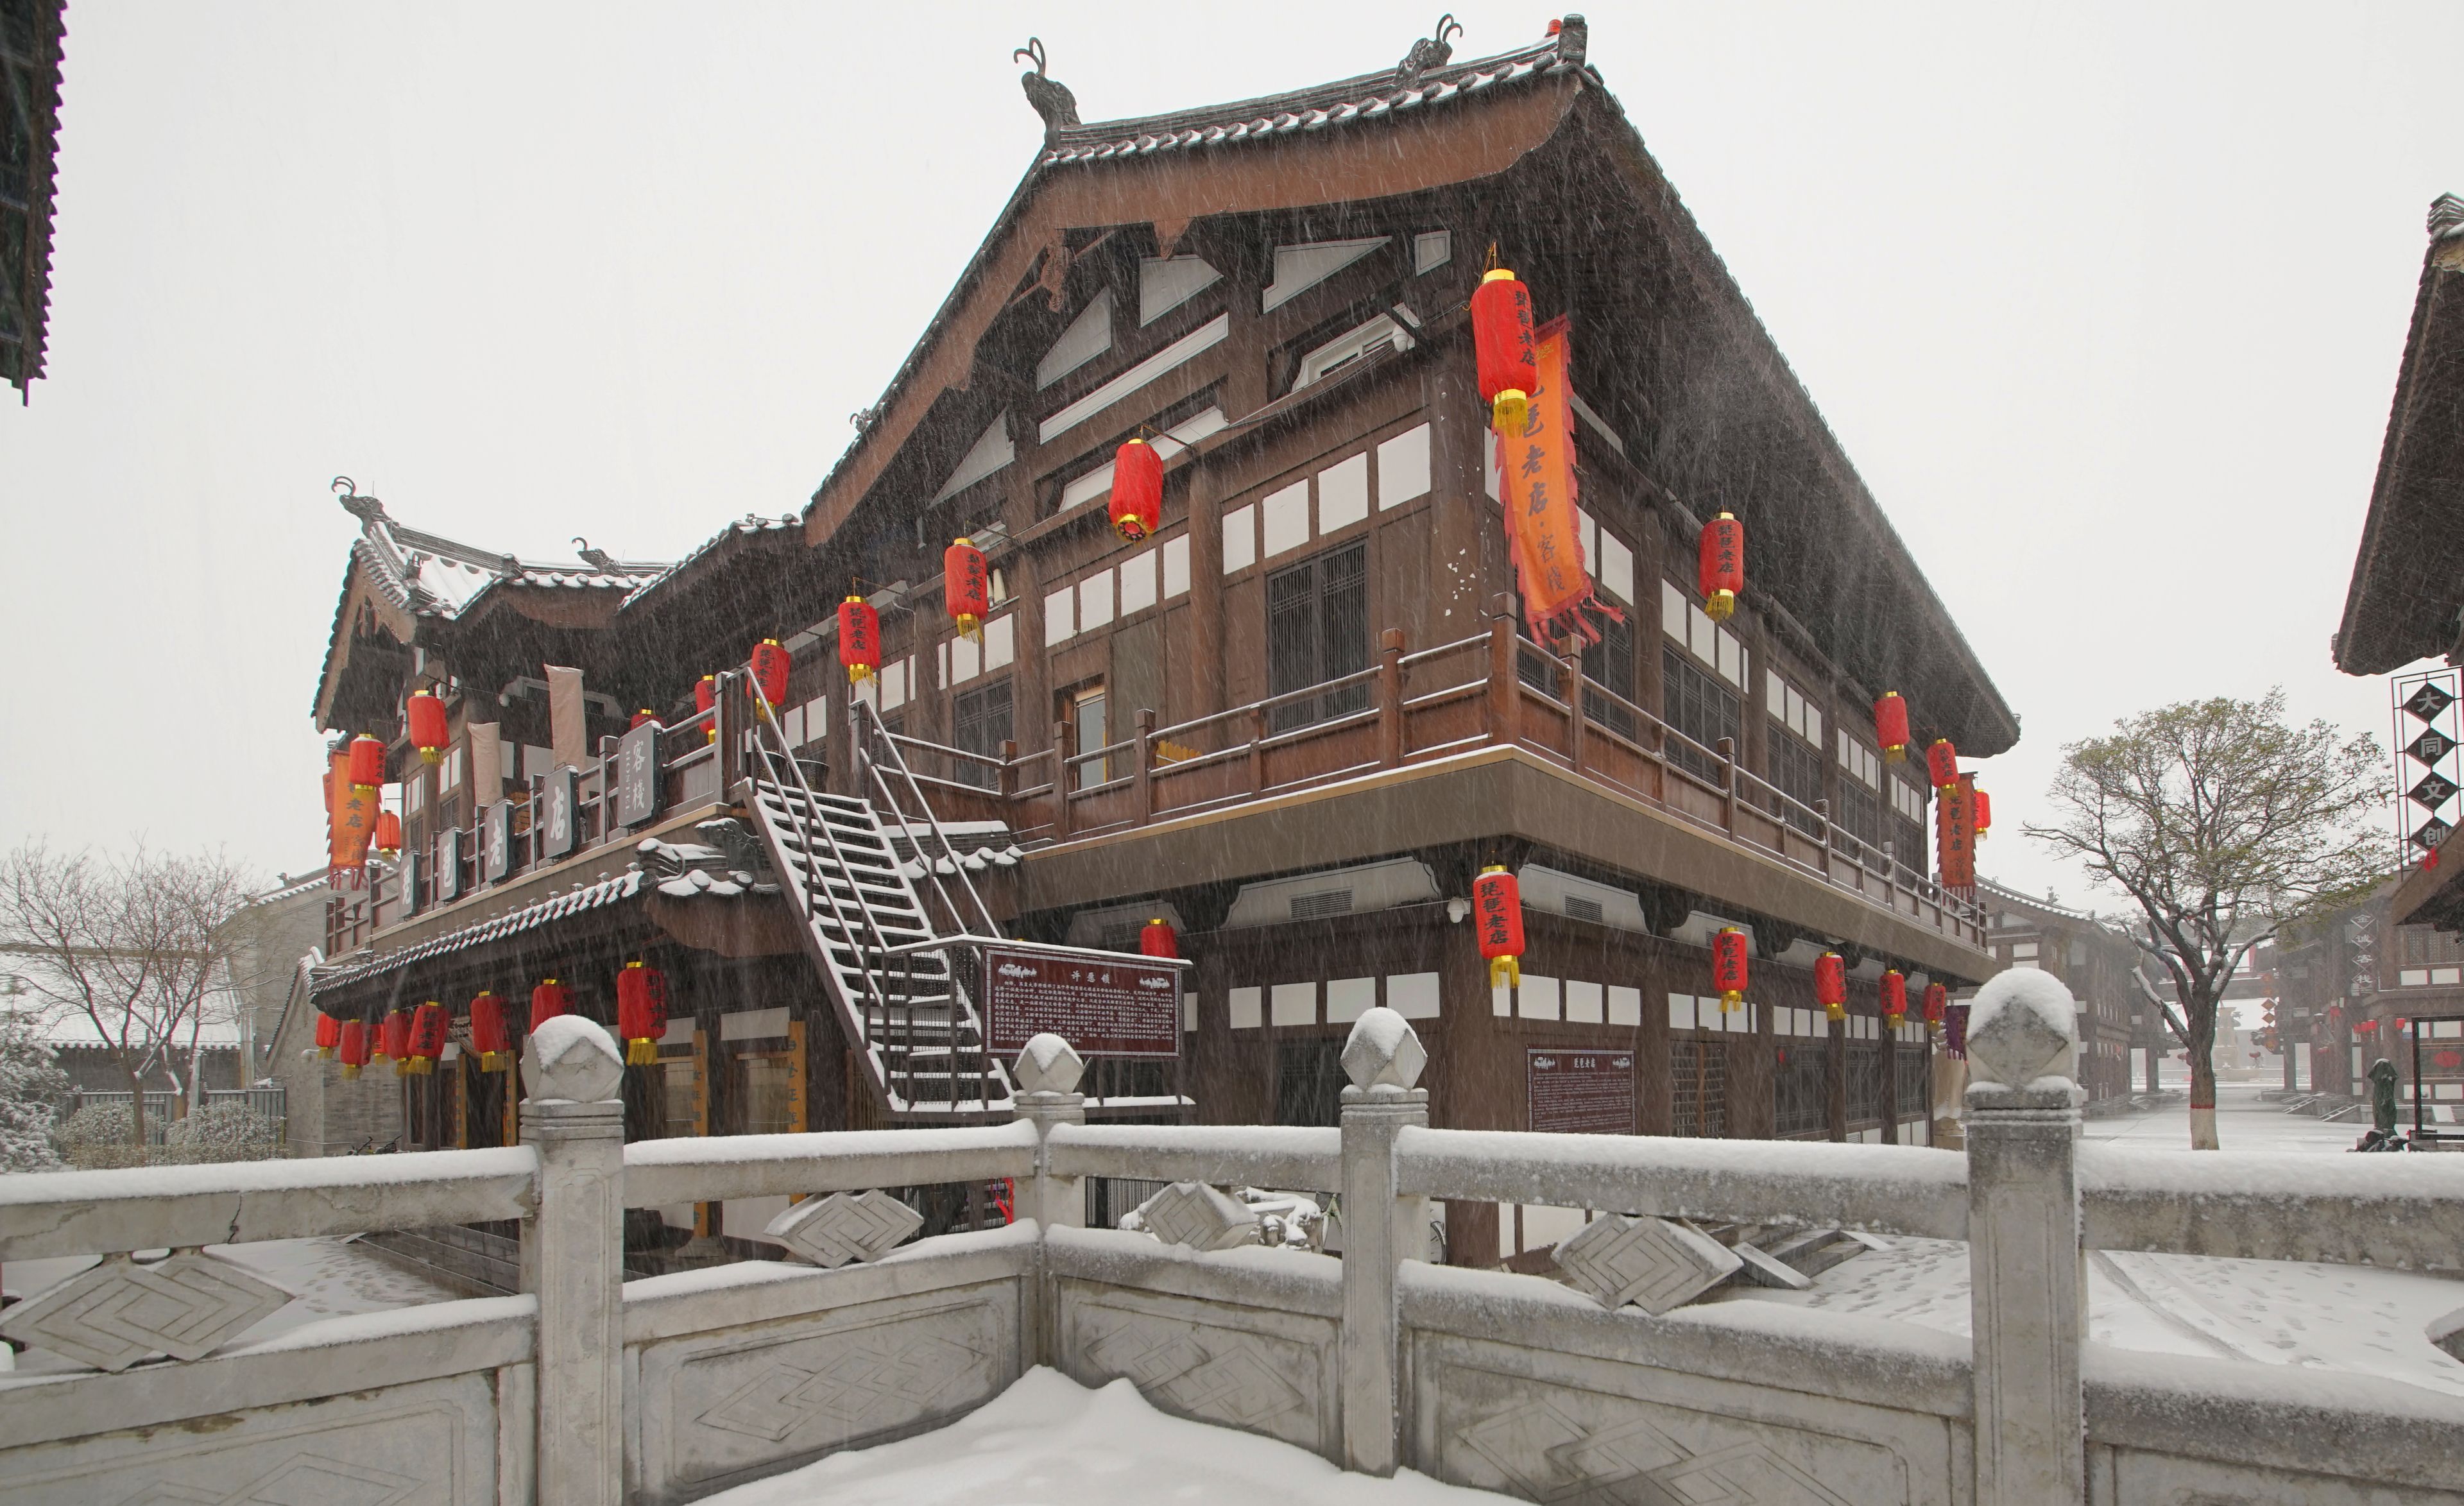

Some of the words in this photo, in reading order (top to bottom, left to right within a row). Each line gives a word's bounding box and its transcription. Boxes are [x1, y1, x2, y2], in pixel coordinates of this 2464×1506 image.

[1515, 291, 1536, 366] 琵琶老店
[1718, 524, 1735, 572] 琵琶老店
[848, 607, 866, 651] 琵琶老店
[2417, 692, 2447, 846] 大同文创
[490, 819, 502, 866] 老
[551, 786, 565, 841] 店
[1480, 881, 1508, 945] 琵琶老店
[1721, 936, 1738, 980] 琵琶老店
[2355, 914, 2373, 984] 金诚客栈
